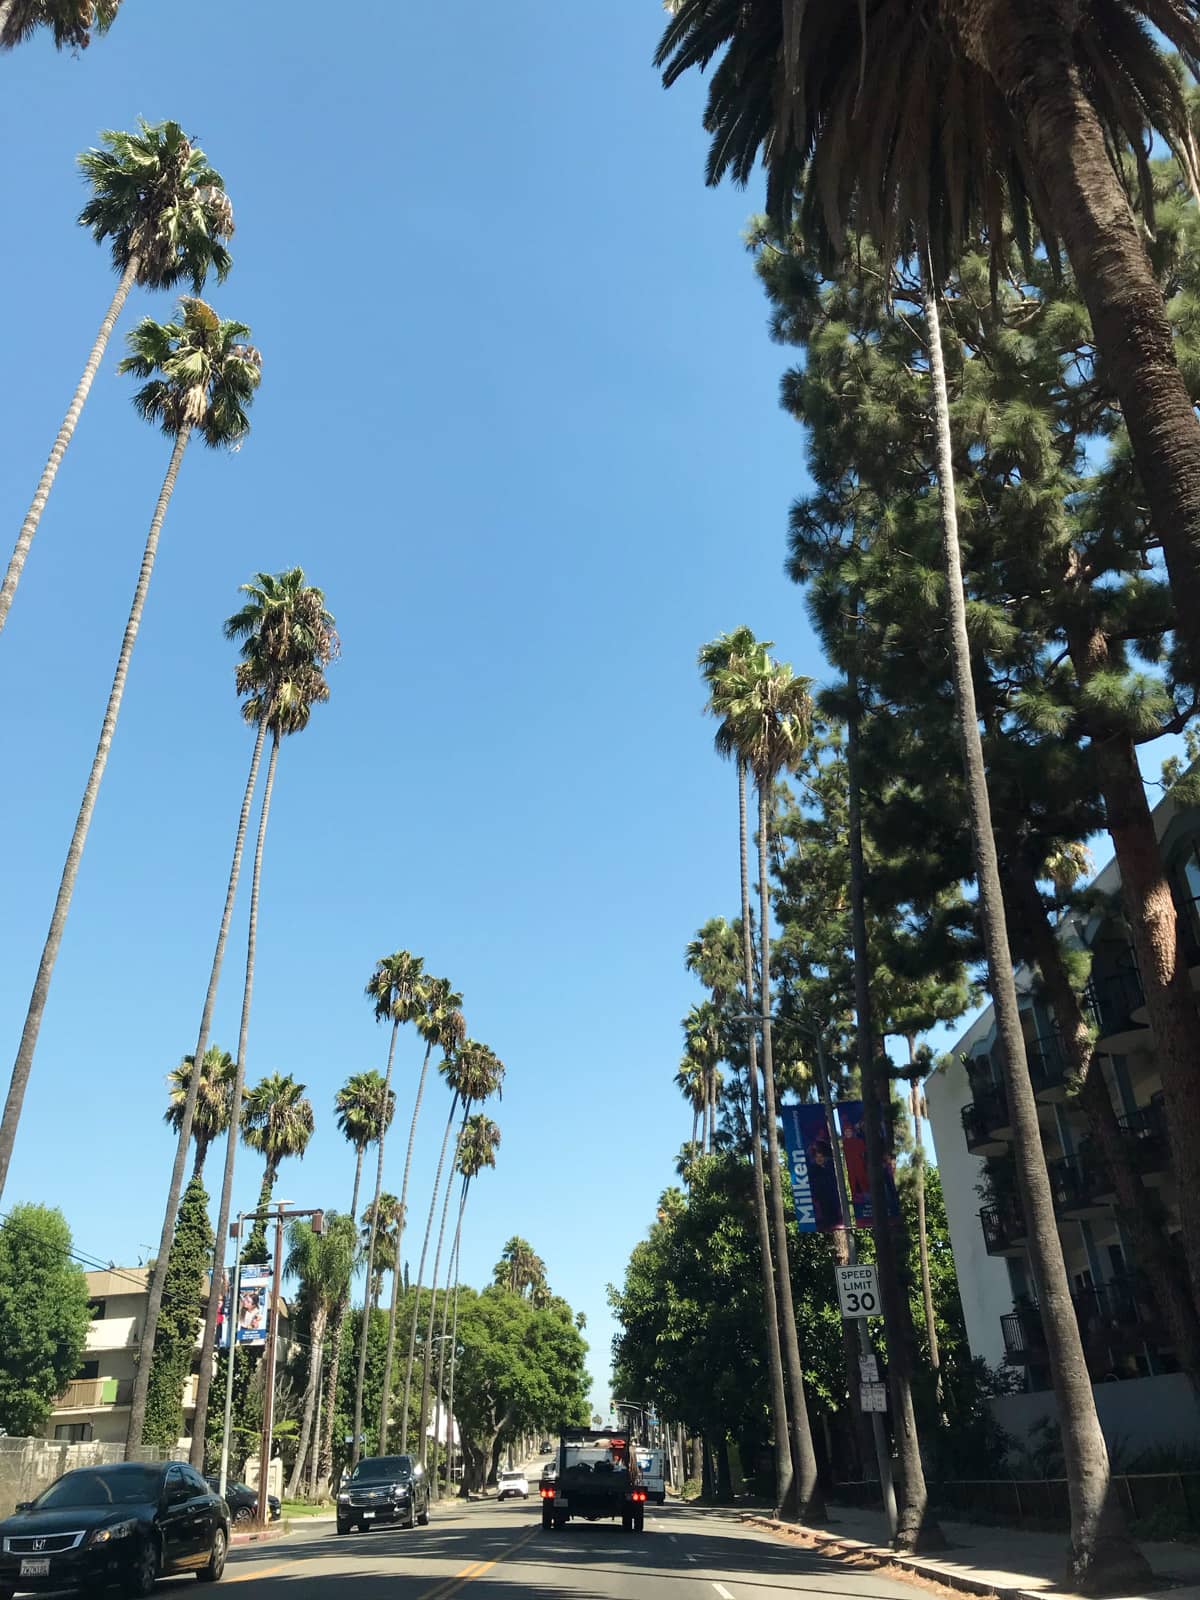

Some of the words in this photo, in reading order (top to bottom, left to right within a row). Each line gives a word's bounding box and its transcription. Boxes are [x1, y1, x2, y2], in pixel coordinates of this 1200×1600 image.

[792, 1149, 816, 1224] Milken
[842, 1269, 872, 1280] SPEED
[844, 1281, 872, 1291] LIMIT
[847, 1292, 875, 1312] 30
